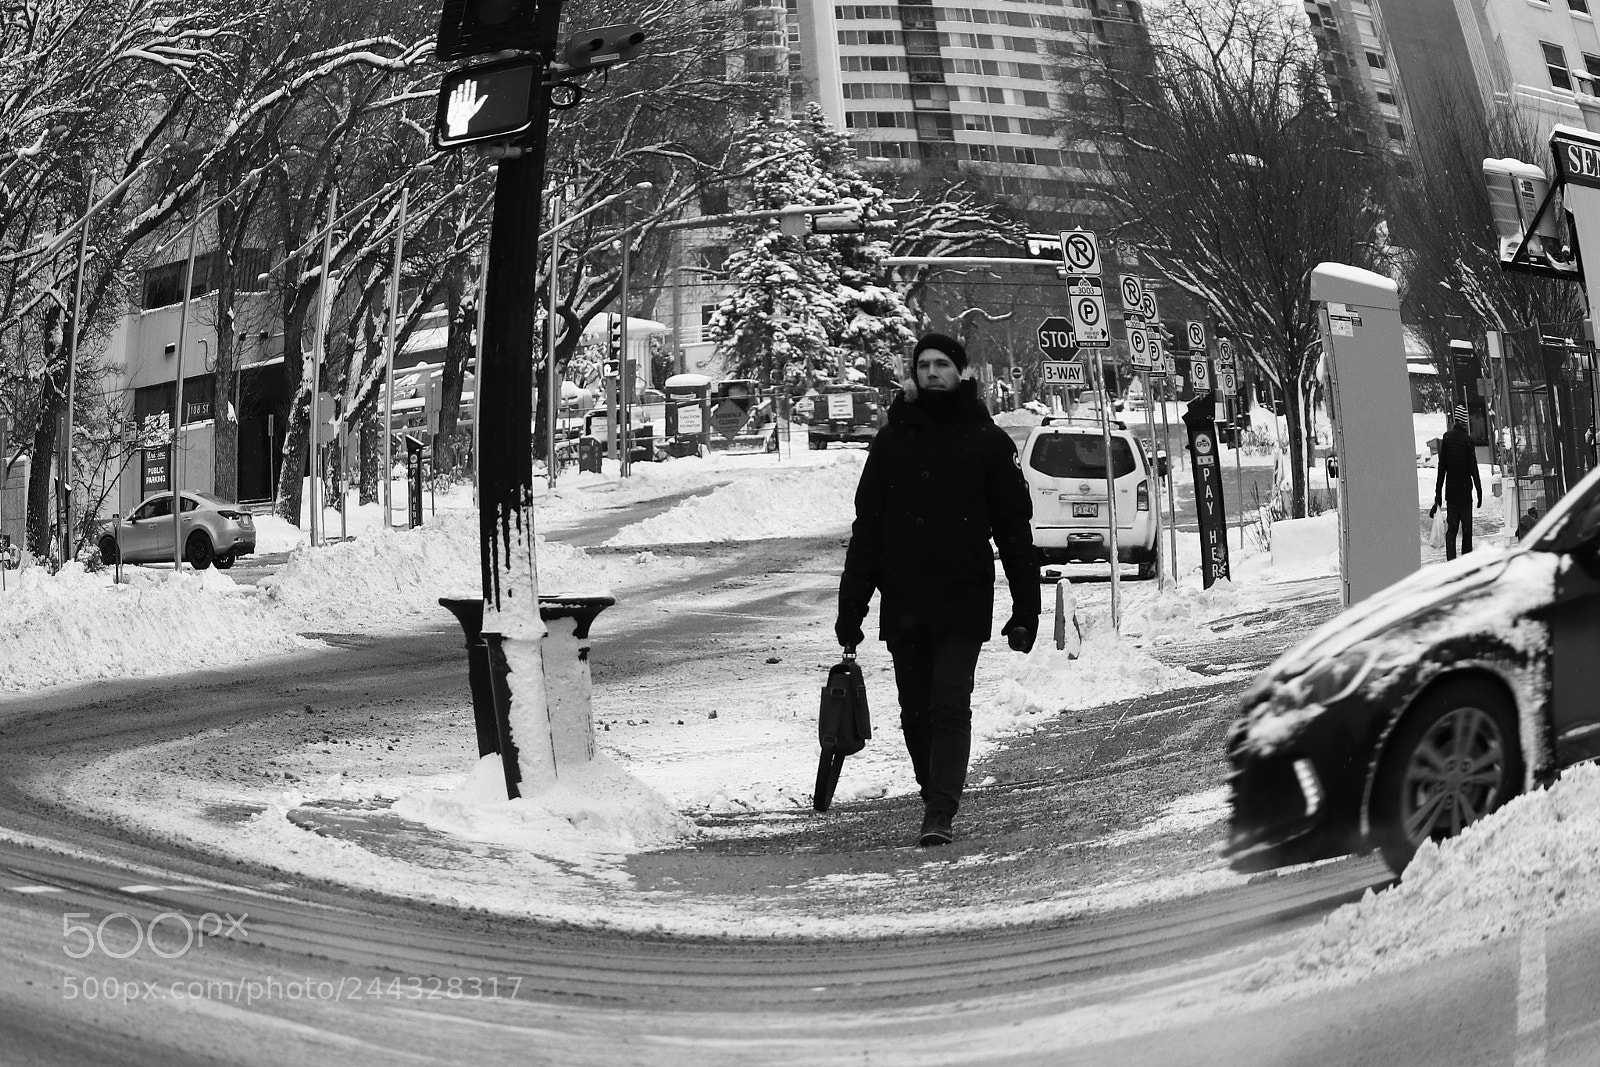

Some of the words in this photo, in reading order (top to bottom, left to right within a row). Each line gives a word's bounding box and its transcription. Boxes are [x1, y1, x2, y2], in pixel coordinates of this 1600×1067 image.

[1077, 286, 1095, 295] 3003
[1083, 304, 1094, 320] P
[1045, 366, 1081, 380] 3-WAY
[190, 405, 201, 415] 108
[202, 404, 210, 414] ST
[147, 466, 164, 475] PUBLIC
[145, 475, 166, 484] PARKING
[1203, 467, 1215, 516] PAY
